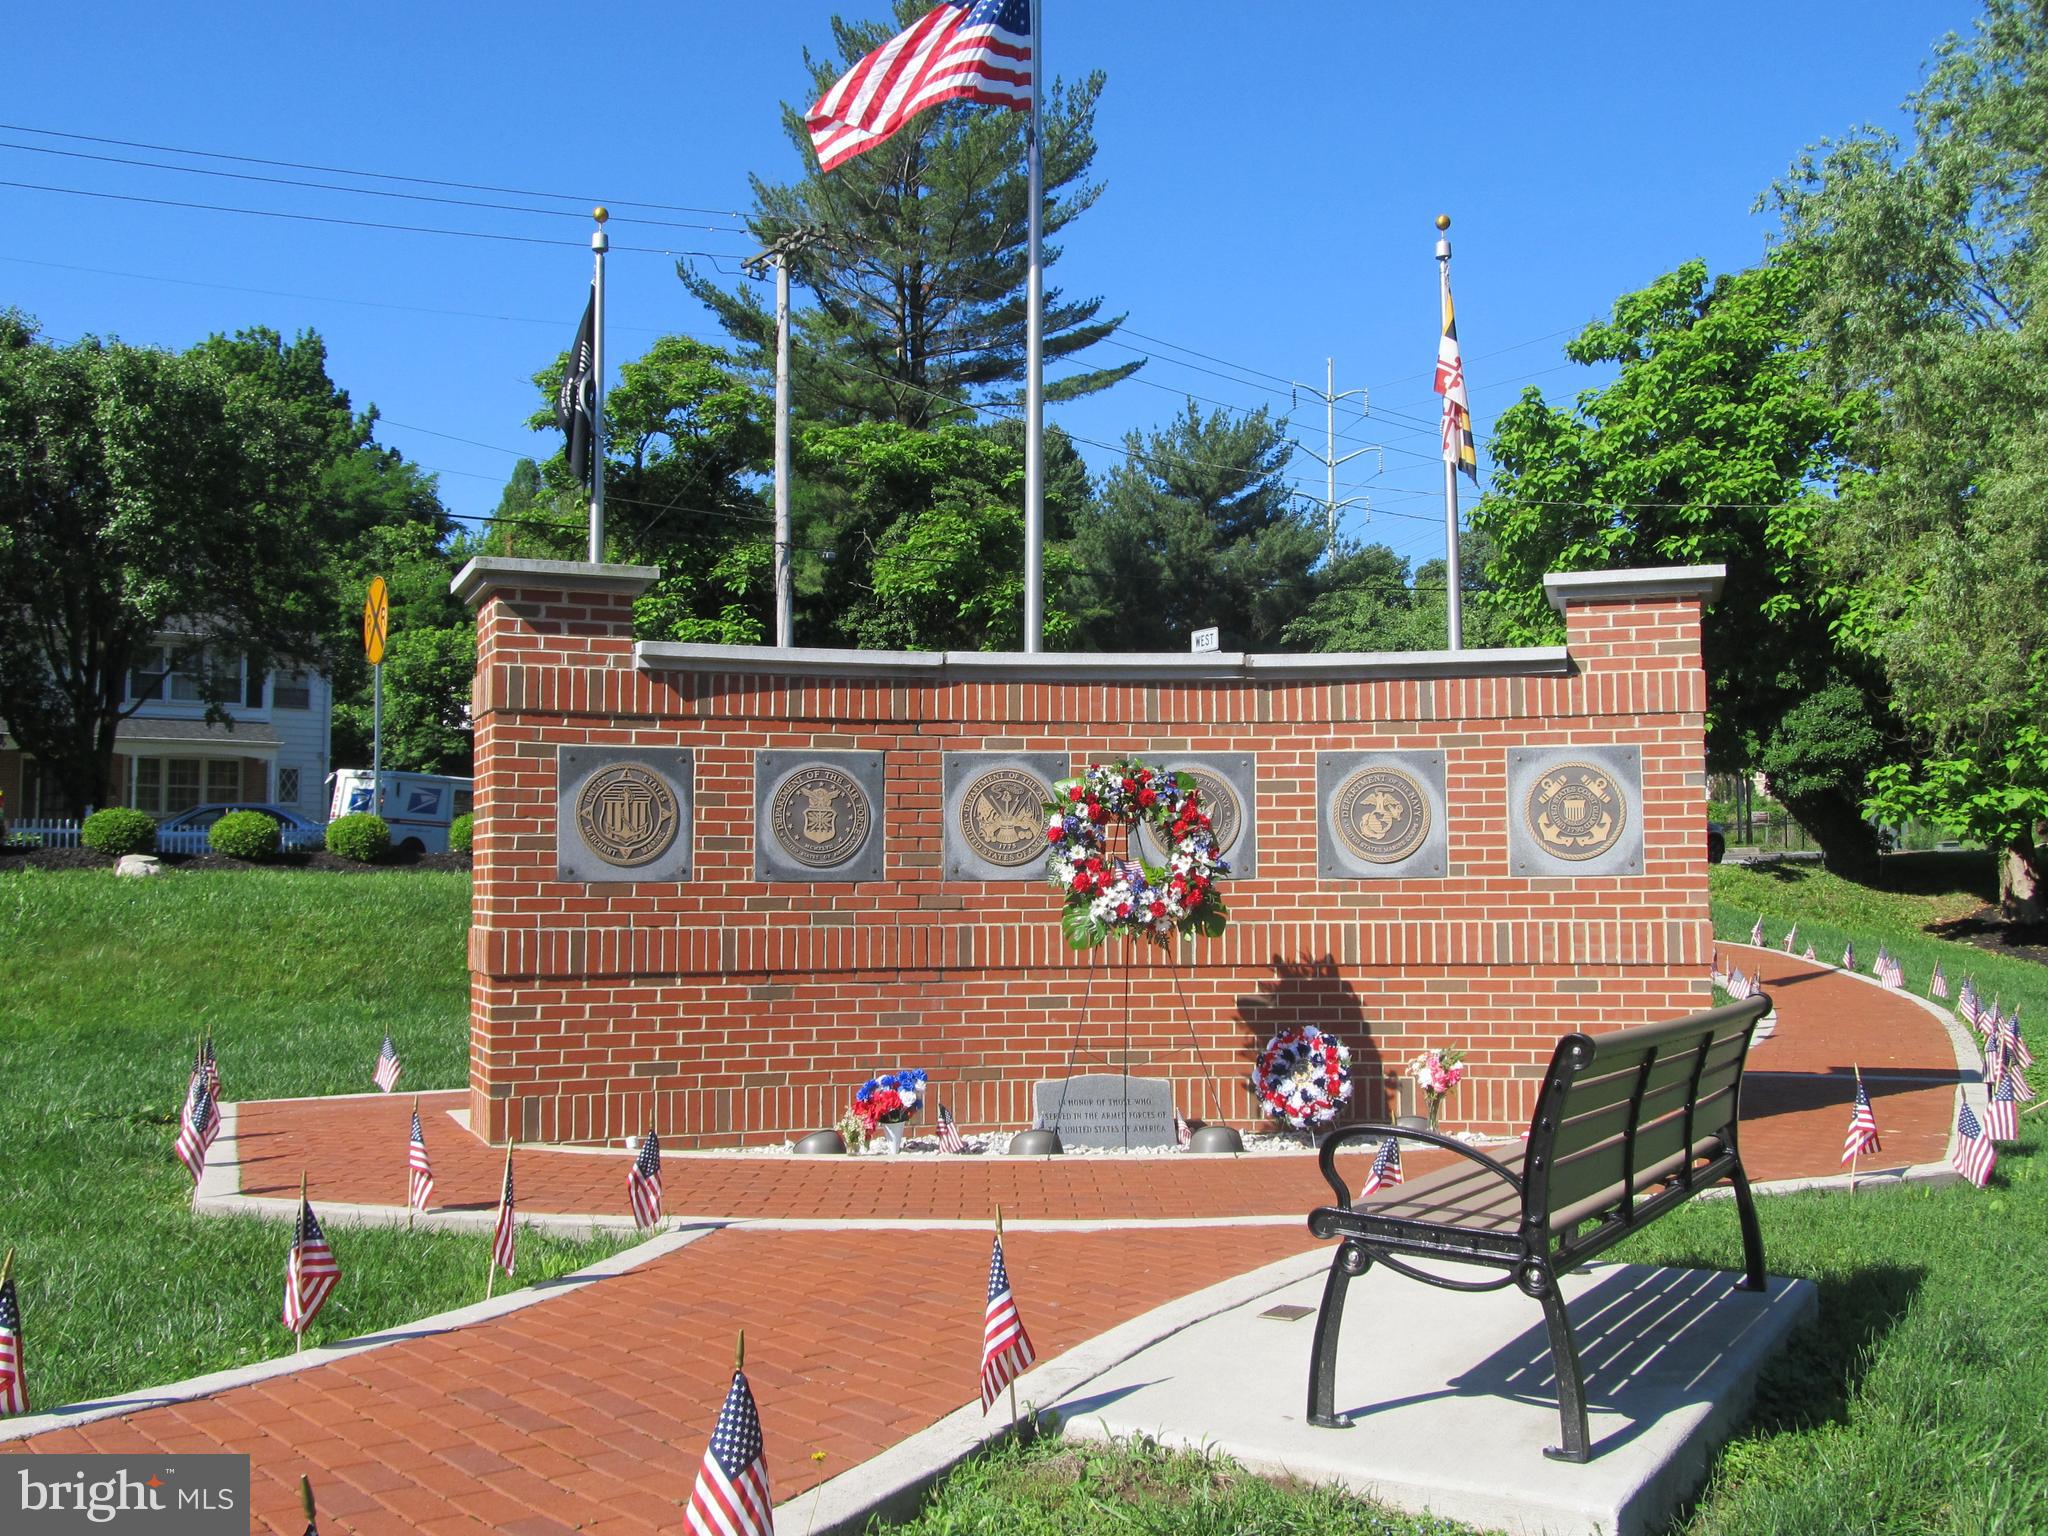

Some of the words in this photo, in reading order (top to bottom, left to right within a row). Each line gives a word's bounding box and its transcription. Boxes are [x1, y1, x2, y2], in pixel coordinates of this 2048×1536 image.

[1195, 633, 1214, 648] WEST
[584, 777, 609, 803] UNITED
[642, 775, 668, 802] STATES
[775, 776, 804, 830] DEPARTMENT
[806, 770, 820, 779] OF
[824, 771, 843, 784] THE
[844, 783, 860, 800] AIR
[854, 803, 865, 834] FORCE
[963, 772, 1004, 813] DEPARTMENT
[1008, 772, 1020, 780] OF
[1022, 776, 1038, 790] THE
[1204, 780, 1217, 792] THE
[1217, 791, 1231, 808] NAVY
[1342, 774, 1386, 817] DEPARTMENT
[1398, 782, 1410, 792] THE
[1408, 792, 1421, 817] NAVY
[1552, 786, 1577, 804] STATES
[1577, 786, 1598, 804] COAST
[1550, 804, 1567, 830] UNITED
[1584, 805, 1599, 827] GUARD
[585, 825, 618, 856] MERCHANT
[640, 830, 666, 854] MARINE
[964, 820, 982, 850] UNITED
[982, 848, 1015, 860] STATES
[1016, 850, 1027, 858] OF
[1344, 824, 1362, 845] UNITED
[1360, 844, 1382, 852] STATES
[1383, 841, 1407, 853] MARINE
[1406, 822, 1419, 841] CORPS
[1068, 1098, 1092, 1106] HONOR
[1096, 1098, 1105, 1106] OF
[1074, 1112, 1082, 1120] IN
[1085, 1112, 1098, 1120] THE
[1101, 1112, 1125, 1120] ARMED
[1064, 1126, 1092, 1134] UNITED
[1094, 1126, 1119, 1134] STATES
